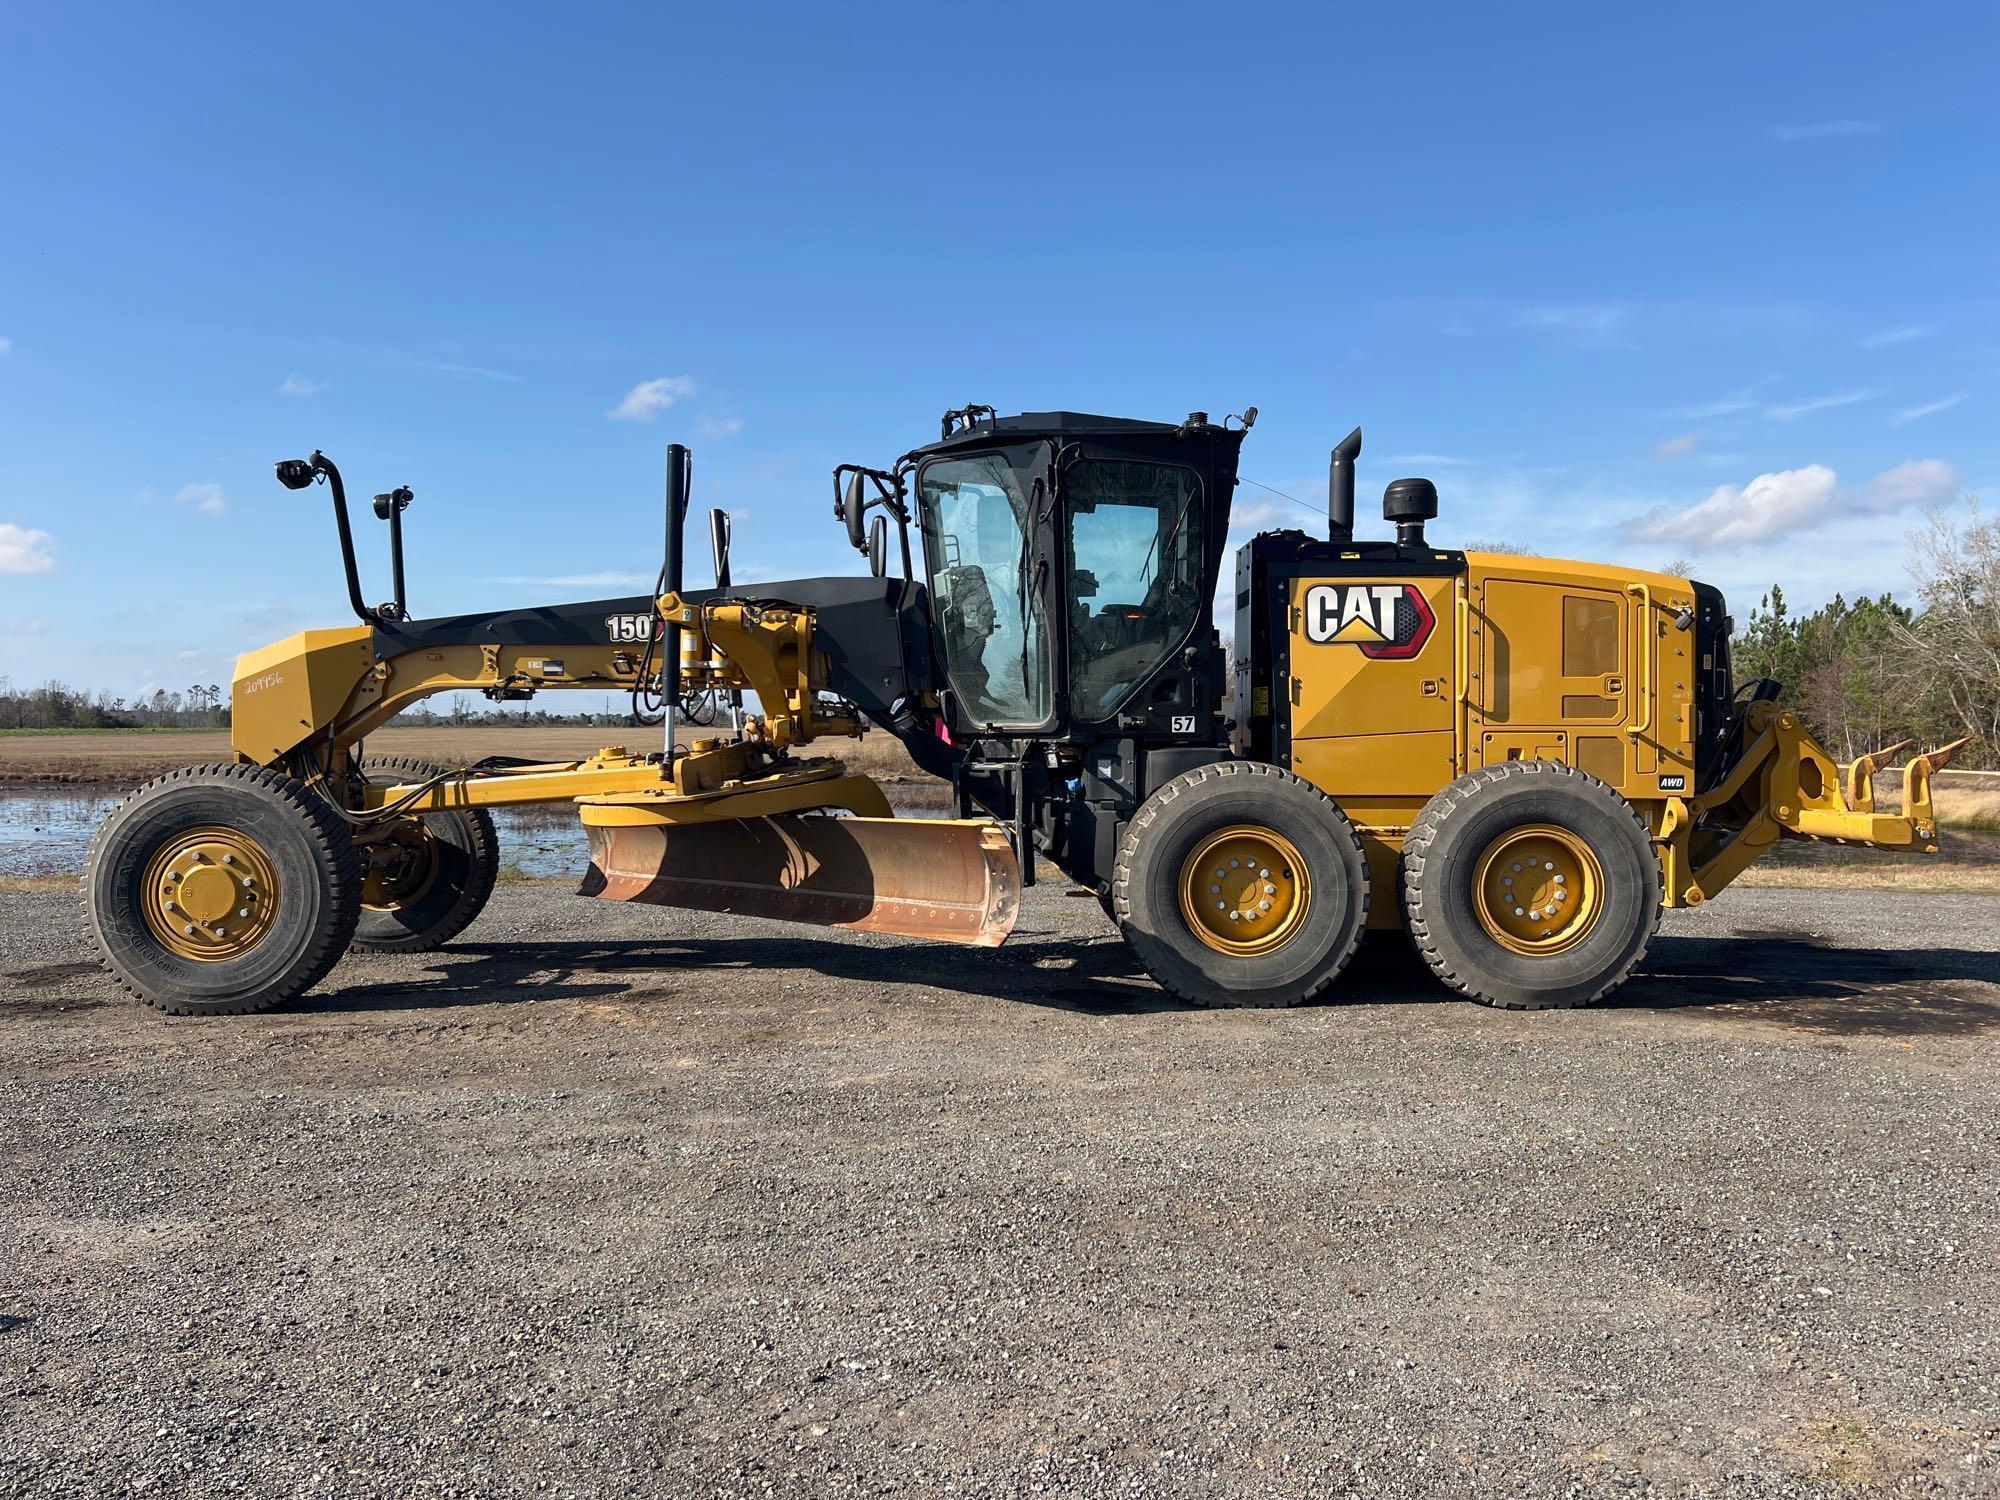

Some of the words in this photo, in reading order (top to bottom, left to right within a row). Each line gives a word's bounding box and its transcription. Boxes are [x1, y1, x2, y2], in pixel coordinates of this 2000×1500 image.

[1307, 586, 1402, 642] CAT
[245, 671, 284, 694] 209956
[1173, 717, 1193, 731] 57
[1660, 777, 1684, 787] AWD
